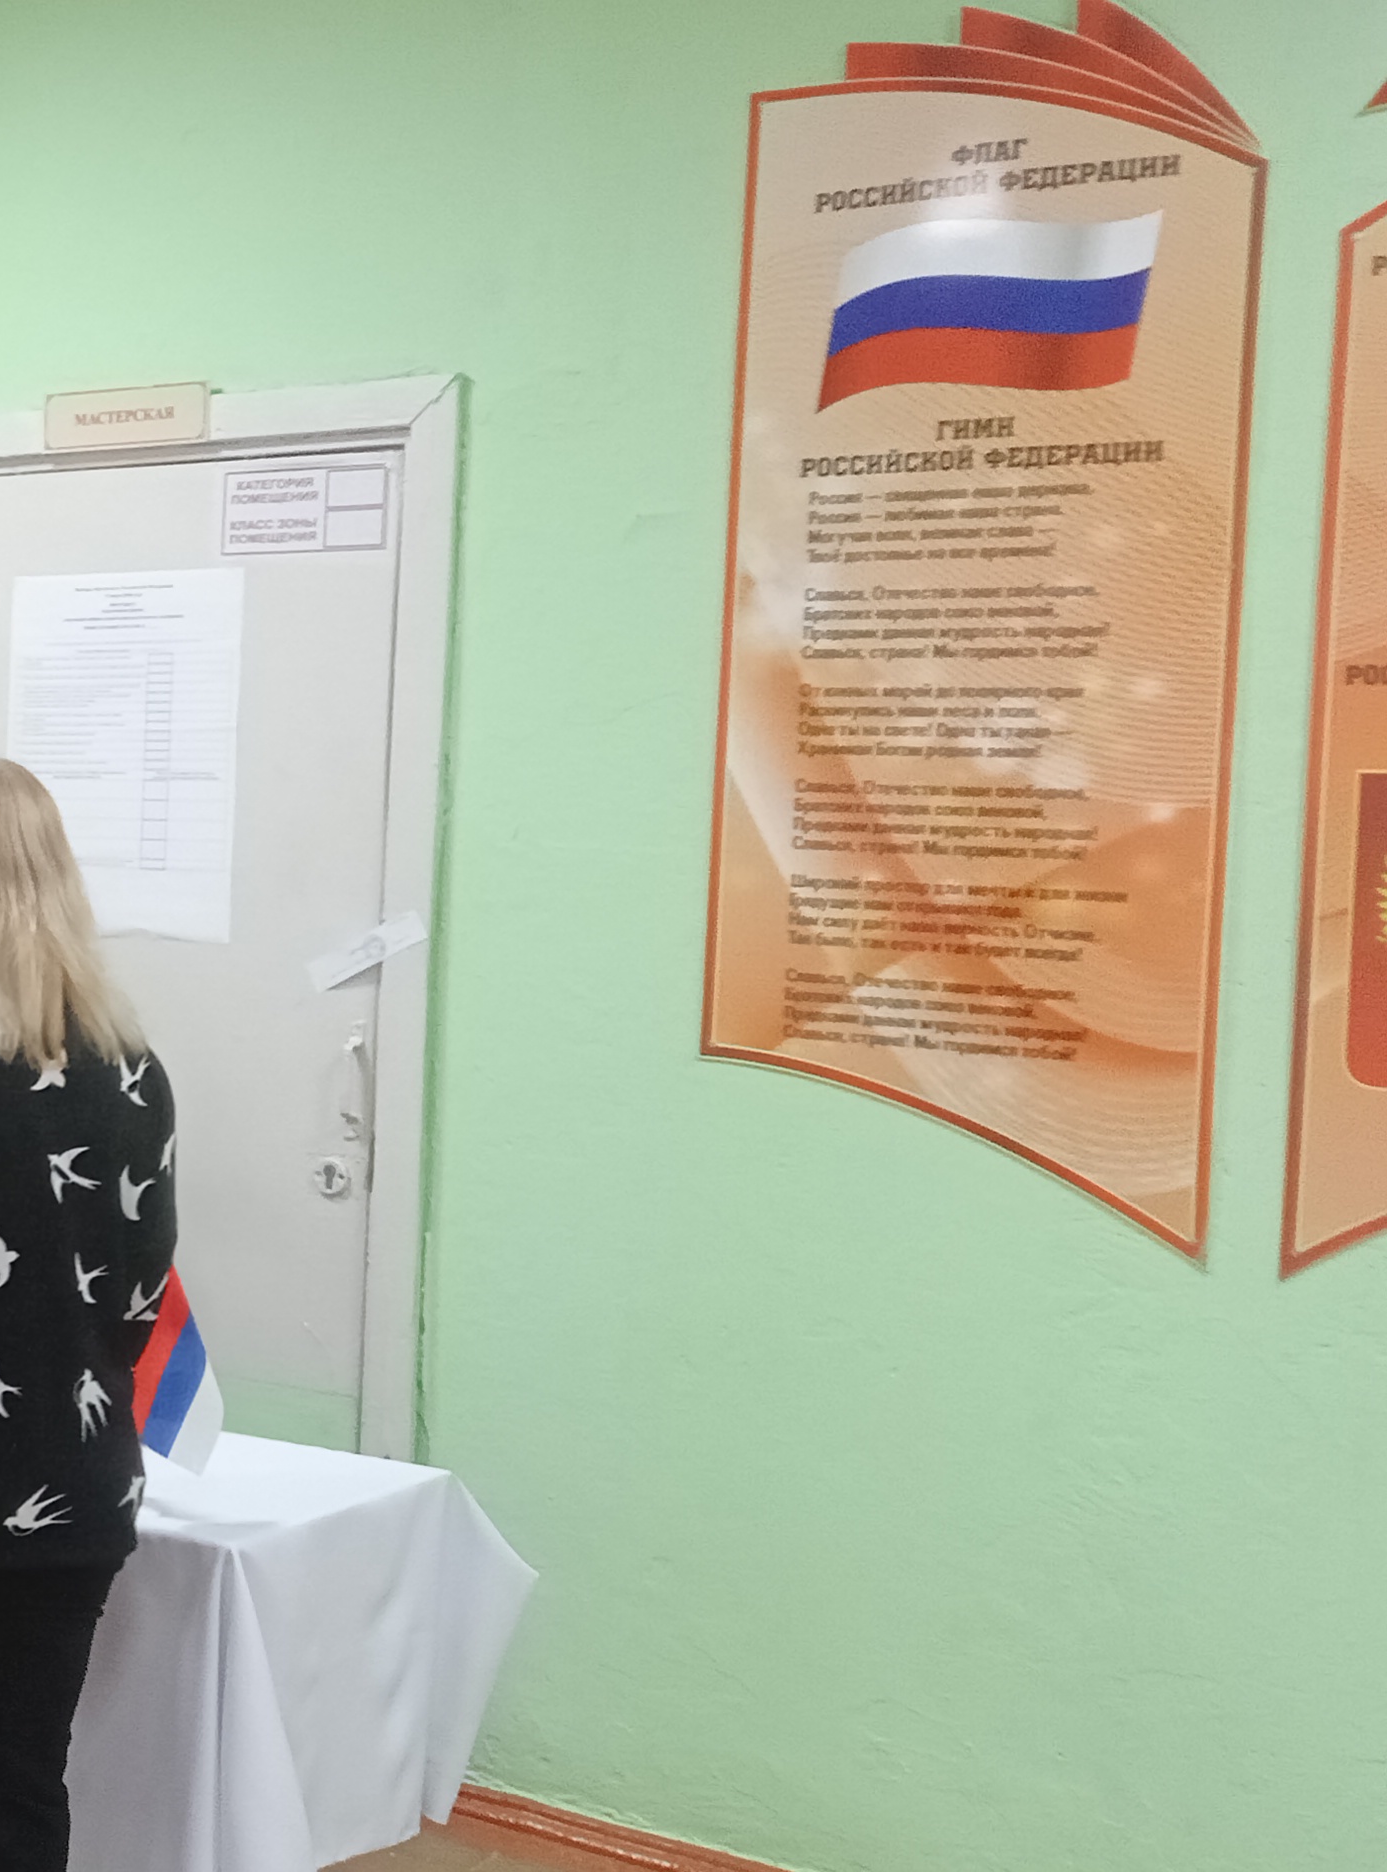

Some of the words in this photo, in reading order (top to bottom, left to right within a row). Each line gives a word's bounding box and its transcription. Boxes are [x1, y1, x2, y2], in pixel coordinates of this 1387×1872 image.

[814, 170, 987, 214] РОССИЙСКОЙ
[999, 154, 1182, 192] ФЕДЕРАЦИИ
[75, 406, 175, 426] МАСТЕРСКАЯ
[935, 415, 1015, 442] ГИМН
[799, 444, 974, 479] РОССИЙСКОЙ
[984, 438, 1165, 470] ФЕДЕРАЦИИ
